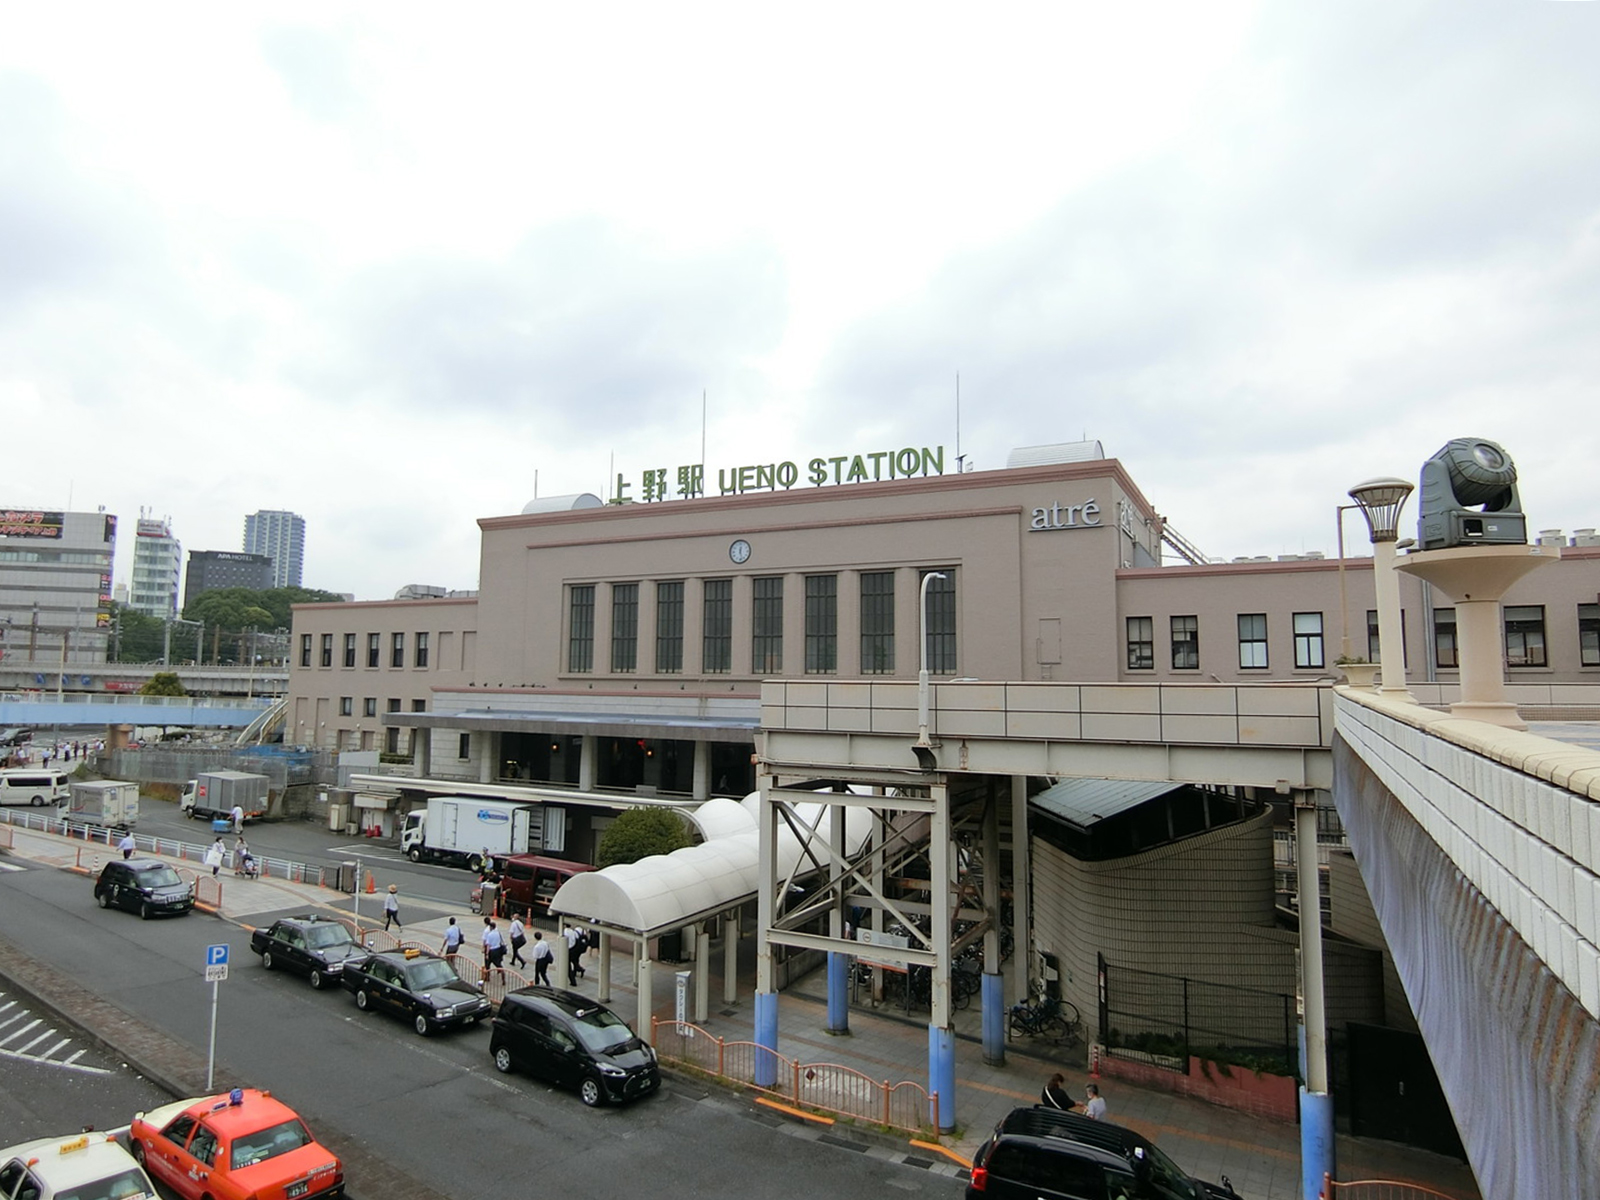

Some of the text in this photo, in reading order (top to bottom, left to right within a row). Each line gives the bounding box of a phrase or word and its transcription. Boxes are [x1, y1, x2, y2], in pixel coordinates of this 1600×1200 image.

[609, 446, 944, 504] 上野駅 UENO STATION
[1031, 498, 1100, 529] atré
[231, 554, 254, 562] HOTEL
[212, 946, 226, 964] P
